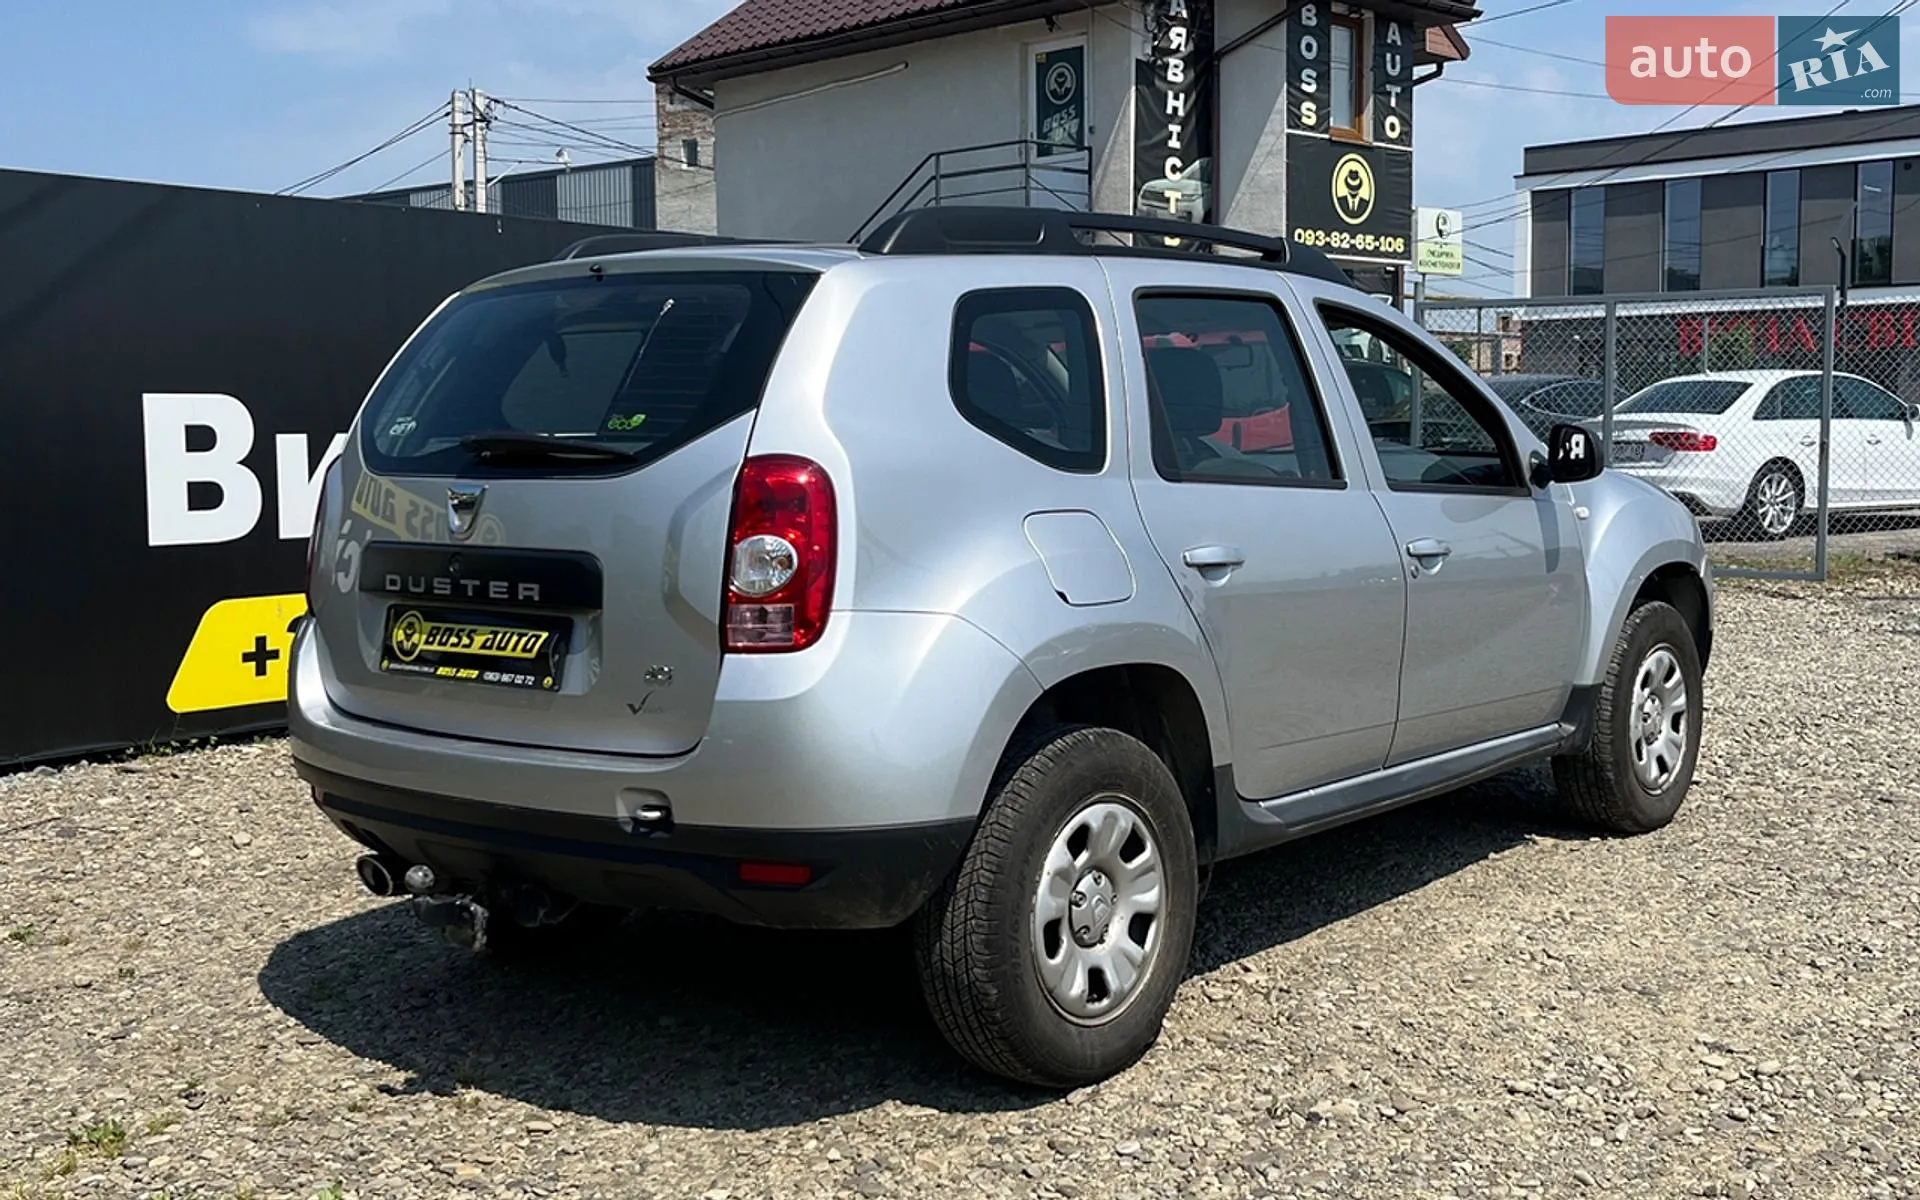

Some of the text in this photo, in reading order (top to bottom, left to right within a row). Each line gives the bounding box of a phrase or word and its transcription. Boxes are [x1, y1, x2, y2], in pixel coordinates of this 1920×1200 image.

[1299, 3, 1319, 127] BOSS
[1384, 21, 1402, 140] AUTO
[1294, 228, 1405, 253] 093-82-65-106
[385, 574, 541, 601] DUSTER
[423, 626, 477, 649] BOSS
